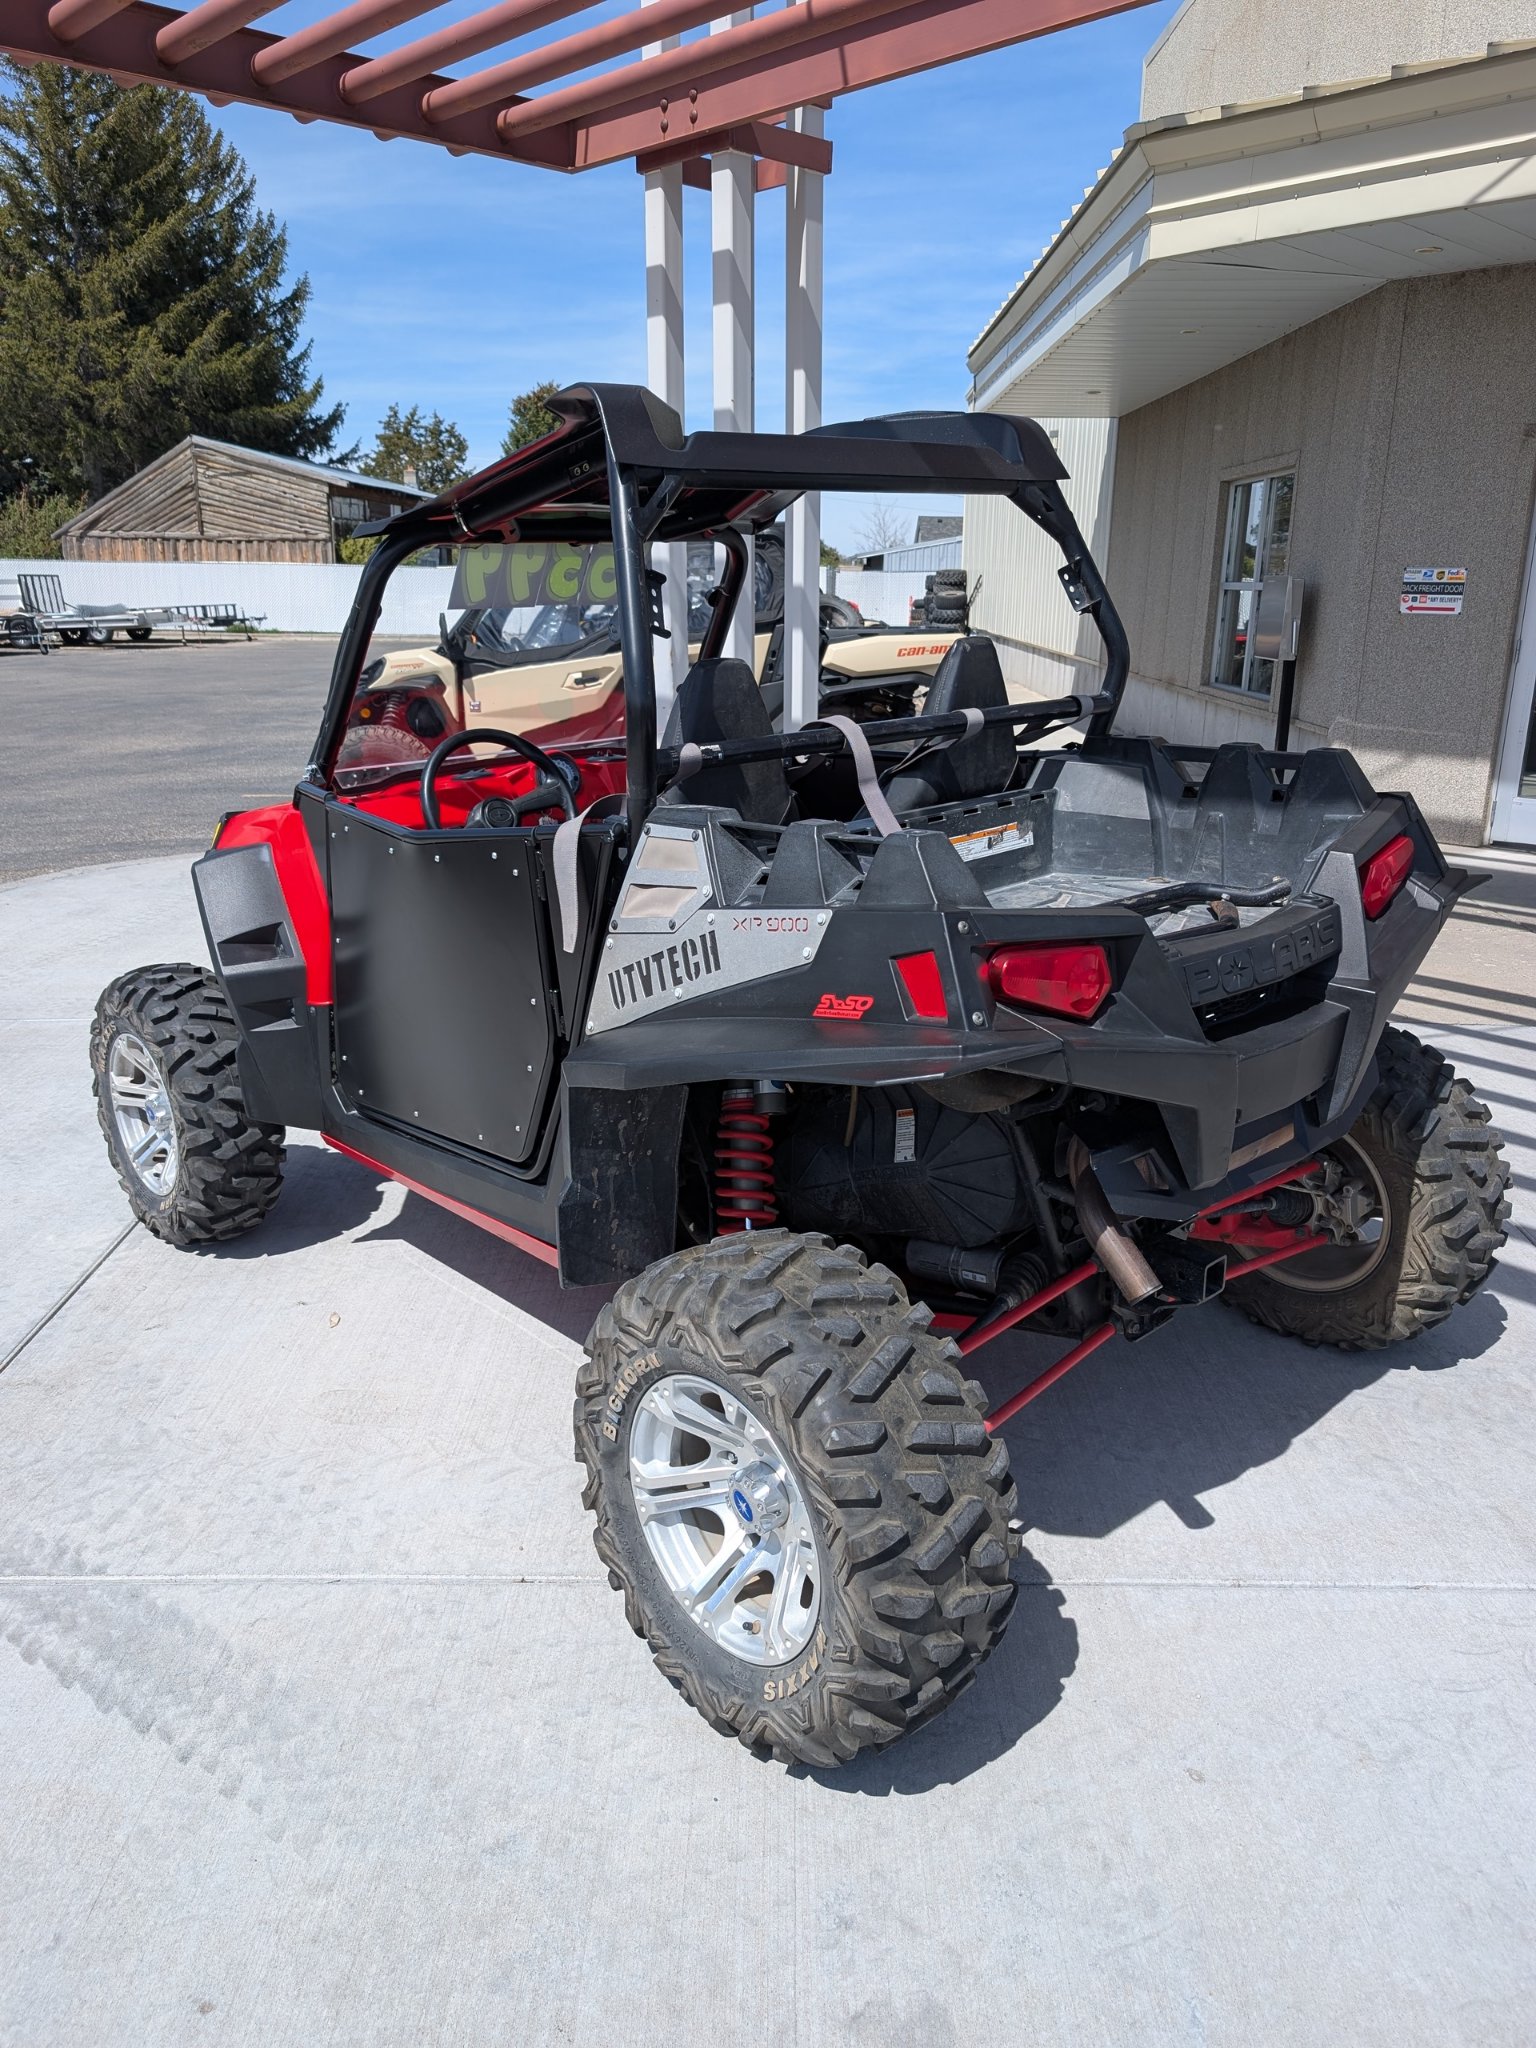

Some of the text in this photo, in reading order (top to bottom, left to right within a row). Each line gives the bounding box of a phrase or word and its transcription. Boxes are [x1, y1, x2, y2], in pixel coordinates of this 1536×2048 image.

[1402, 584, 1463, 593] BACK FREIGHT DOOR
[732, 916, 809, 932] XP 900
[1183, 914, 1339, 1004] POLARIS
[607, 929, 722, 1010] UTVTECH
[602, 1352, 664, 1442] BIGHORN
[763, 1623, 827, 1702] MAXXIS
